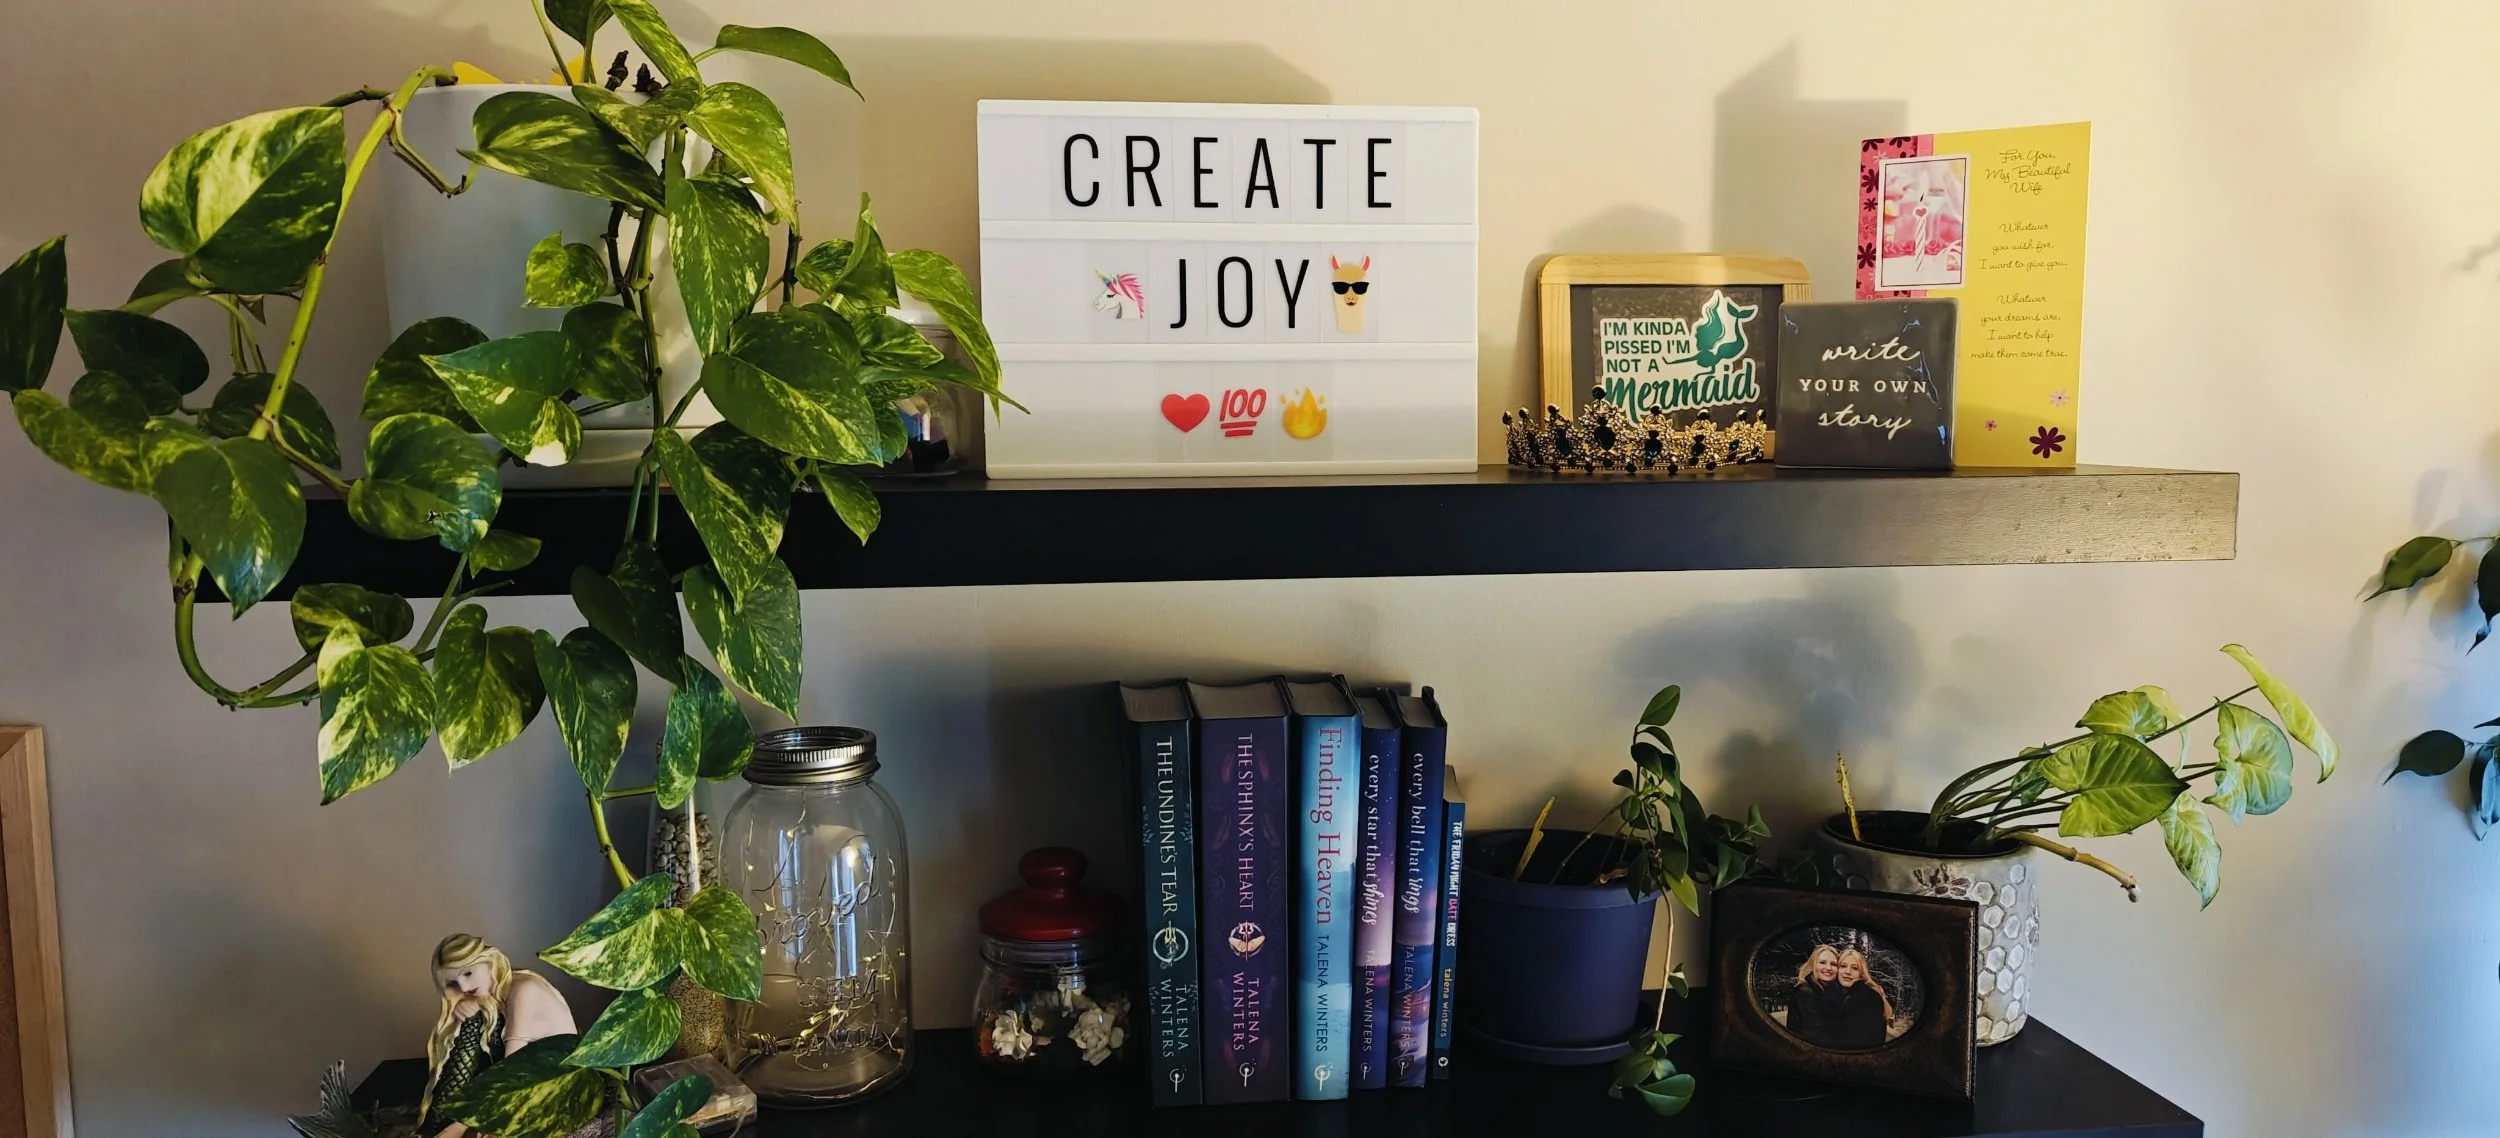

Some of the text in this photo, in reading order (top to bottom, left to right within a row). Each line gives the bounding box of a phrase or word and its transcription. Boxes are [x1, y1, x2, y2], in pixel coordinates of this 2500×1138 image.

[1063, 134, 1393, 209] CREATE
[1985, 163, 2071, 183] My Beautiful
[1998, 149, 2024, 163] For
[2009, 181, 2043, 196] Wife
[1992, 244, 2009, 256] you
[2012, 239, 2033, 251] wish
[1999, 221, 2049, 233] Whatever
[1980, 258, 1988, 270] I
[1989, 260, 2013, 270] want
[2014, 260, 2025, 269] to
[2026, 260, 2045, 272] give
[1170, 256, 1310, 329] JOY
[1996, 292, 2047, 304] Whatever
[1604, 321, 1686, 336] I'M KINDA
[1980, 315, 2002, 326] your
[2004, 312, 2041, 322] dreams
[1987, 328, 2055, 343] I want to help
[1604, 339, 1690, 355] PISSED I'M
[1606, 358, 1660, 373] NOT A
[1822, 336, 1921, 361] write
[1970, 349, 1994, 359] make
[1996, 348, 2018, 358] them
[2020, 350, 2044, 358] come
[1220, 388, 1267, 422] 100
[1605, 361, 1757, 424] Mermaid
[1799, 378, 1927, 393] YOUR OWN
[1818, 403, 1912, 440] story
[1156, 735, 1178, 917] THE UNDINE'S TEAR
[1237, 733, 1254, 912] THE SPHINX'S HEART
[1310, 727, 1343, 925] Finding Heaven
[1362, 754, 1385, 926] every star that shines
[1401, 752, 1427, 914] every bell that rings
[1446, 821, 1463, 947] THE FRIDAY NIGHT DATE DRESS
[1160, 978, 1174, 1058] WINTERS
[1175, 984, 1189, 1050] TALENA
[1233, 971, 1245, 1051] WINTERS
[1248, 977, 1260, 1045] TALENA
[1316, 934, 1330, 1052] TALENA WINTERS
[1362, 950, 1376, 1052] TALENA WINTERS
[1400, 945, 1415, 1048] TALENA WINTERS
[1440, 968, 1452, 1038] talena winters
